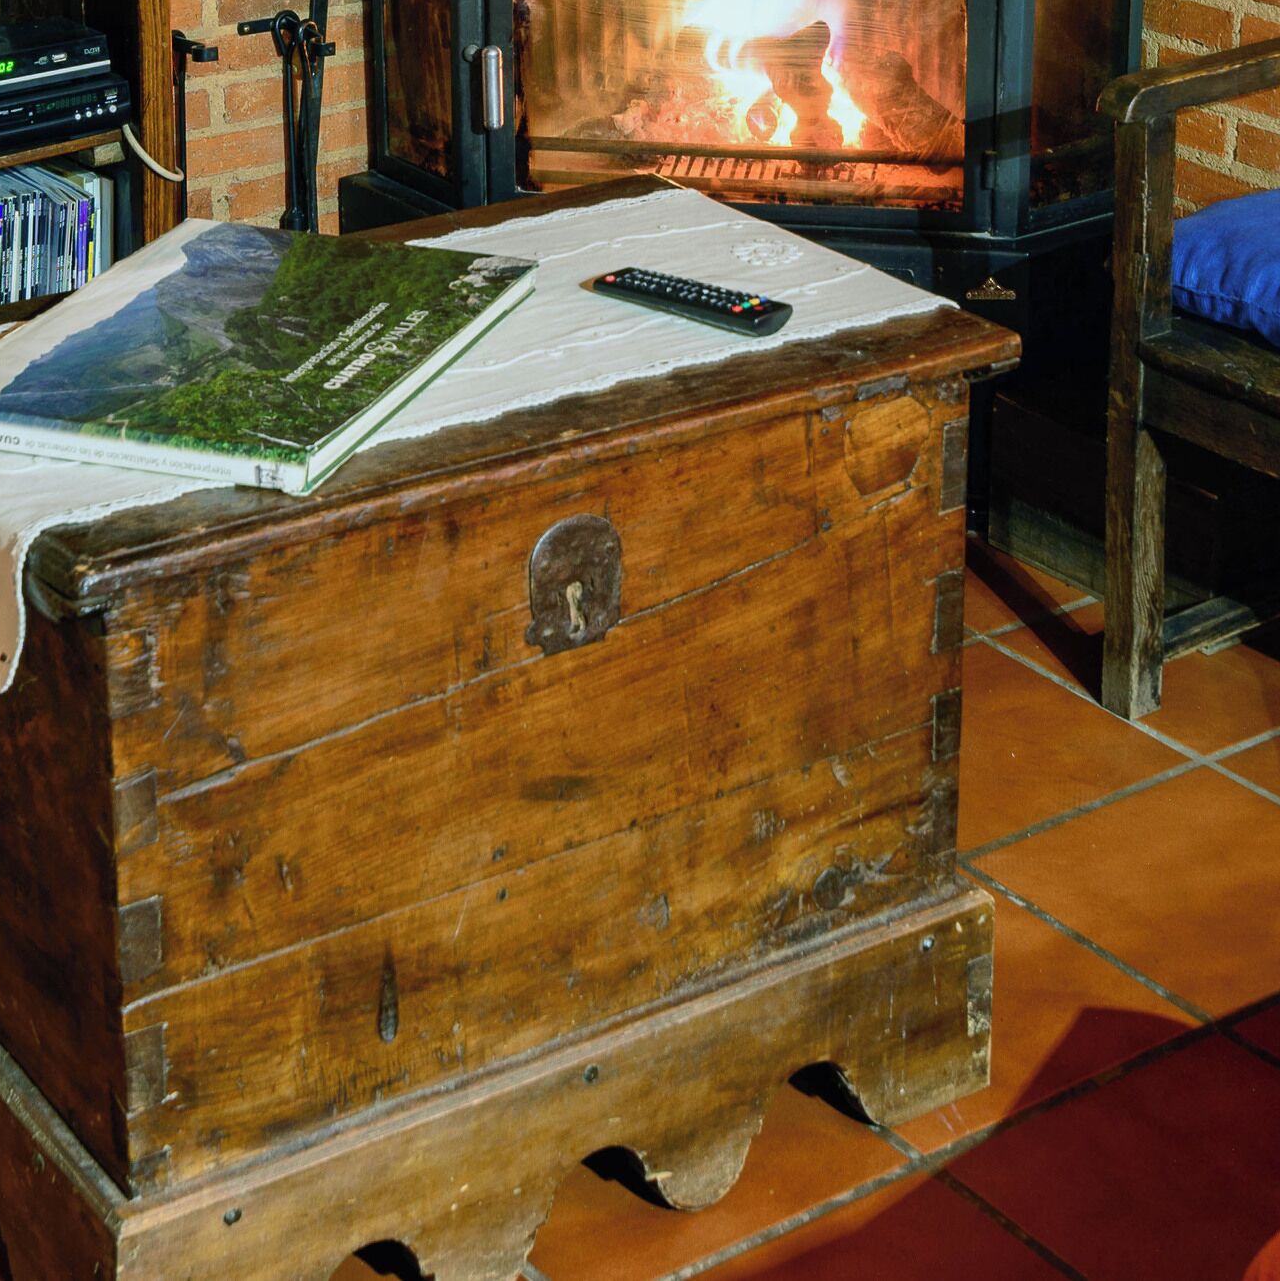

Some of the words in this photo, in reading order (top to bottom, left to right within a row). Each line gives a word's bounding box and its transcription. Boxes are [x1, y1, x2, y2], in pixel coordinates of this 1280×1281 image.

[323, 353, 377, 390] CUATRO
[381, 309, 430, 342] VALLES
[106, 450, 161, 464] Señalización
[168, 458, 232, 476] Interpretación
